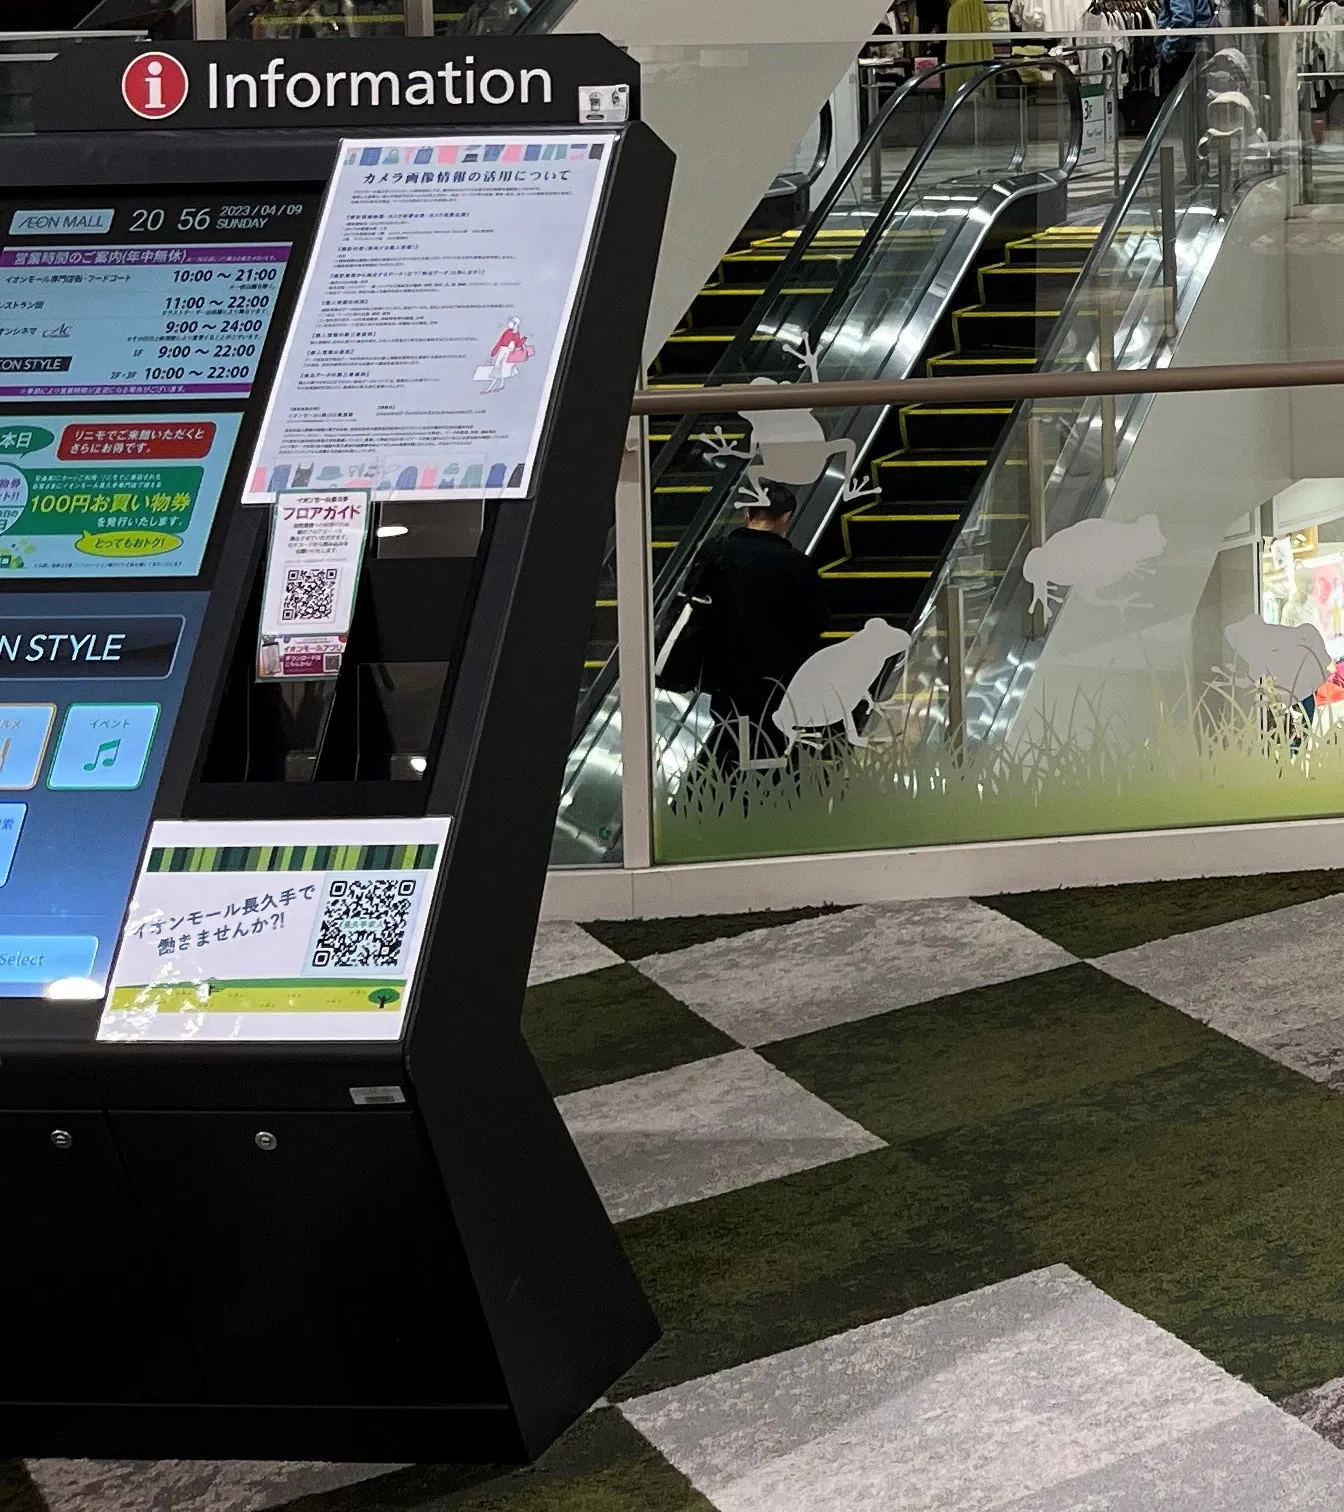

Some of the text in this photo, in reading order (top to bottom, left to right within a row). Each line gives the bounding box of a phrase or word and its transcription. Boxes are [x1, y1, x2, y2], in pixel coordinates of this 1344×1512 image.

[208, 57, 553, 110] Information
[364, 170, 571, 185] カメラ画像情報の活用について
[62, 215, 103, 227] MALL
[129, 208, 210, 231] 20 56
[216, 218, 268, 229] SUNDAY
[173, 270, 212, 283] 10:00
[235, 268, 277, 281] 21:00
[165, 296, 205, 310] 11:00
[228, 295, 270, 308] 22:00
[166, 321, 198, 334] 9:00
[220, 319, 263, 332] 24:00
[157, 346, 191, 359] 9:00
[213, 344, 256, 357] 22:00
[23, 358, 62, 370] STYLE
[145, 367, 185, 380] 10:00
[207, 366, 250, 379] 22:00
[1, 432, 32, 448] 本日
[69, 442, 151, 454] さらにお得です。
[31, 492, 191, 513] 100円お買い物券
[283, 506, 361, 520] フロアガイド
[97, 516, 183, 528] を発行いたします。
[25, 634, 126, 661] STYLE
[89, 719, 131, 729] イベント
